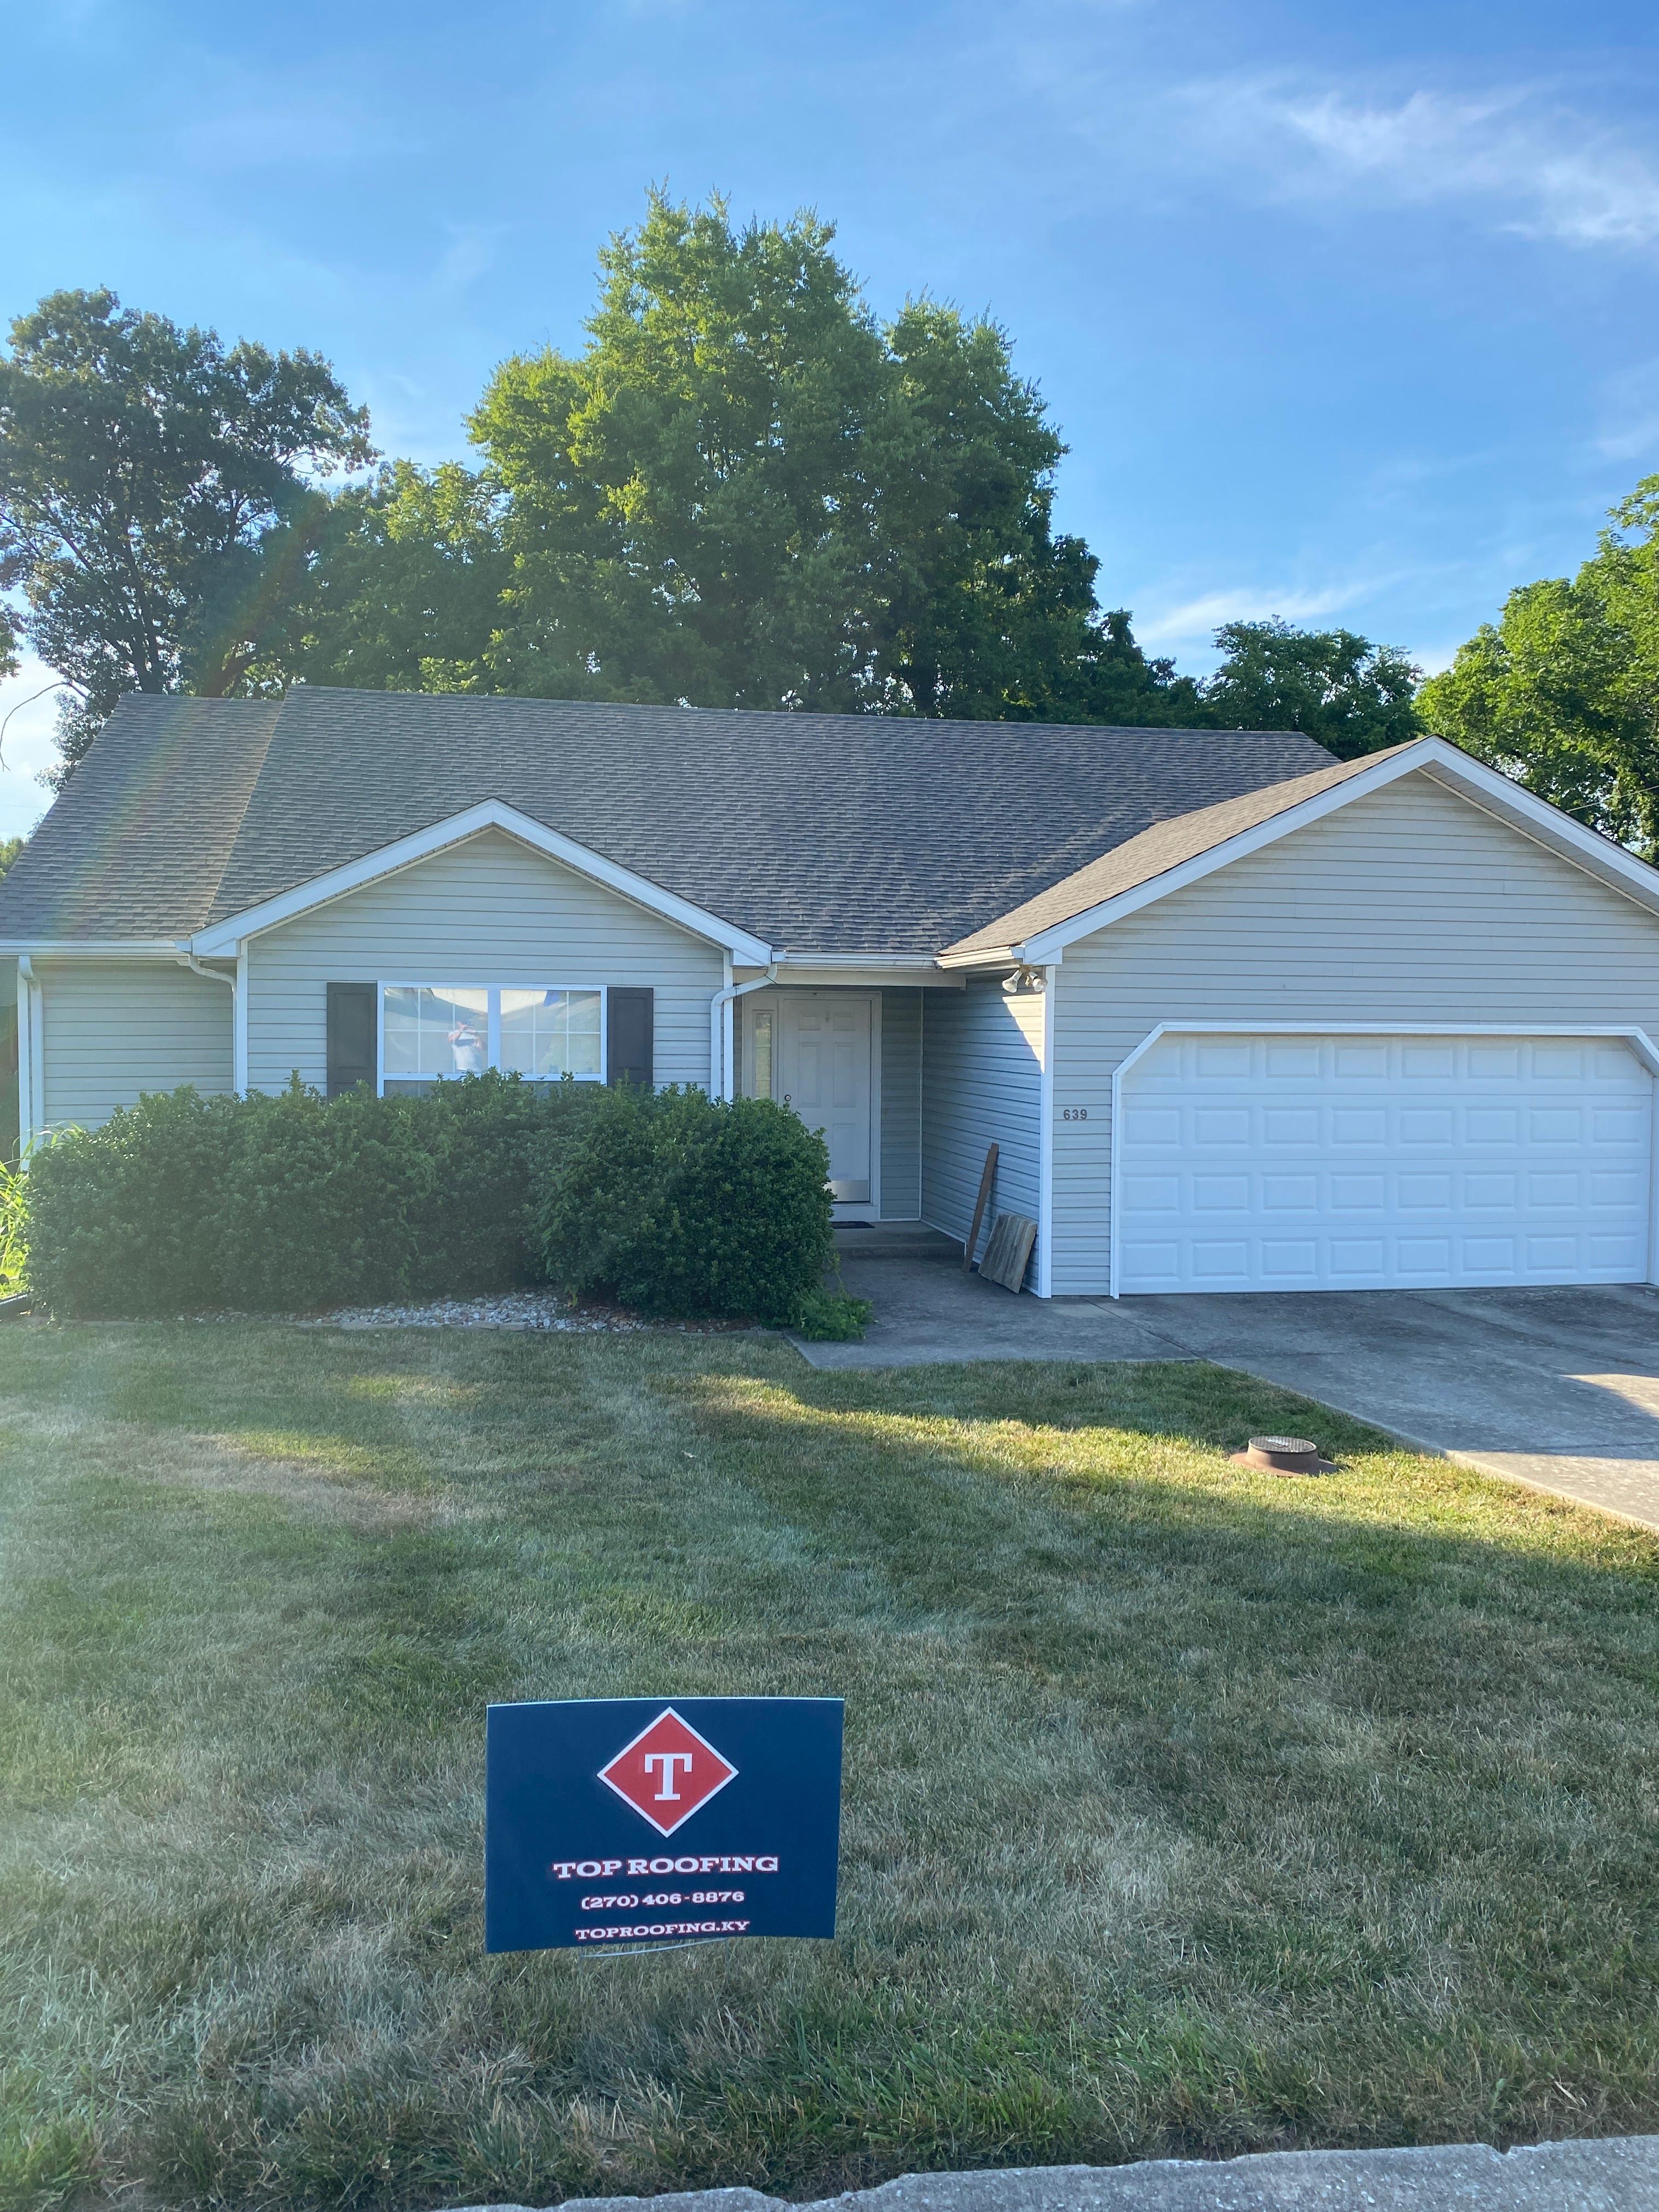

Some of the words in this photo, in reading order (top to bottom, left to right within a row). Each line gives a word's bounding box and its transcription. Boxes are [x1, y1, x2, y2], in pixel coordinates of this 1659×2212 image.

[1063, 1109, 1087, 1120] 639
[644, 1753, 692, 1801] T
[553, 1860, 622, 1878] TOP
[627, 1857, 779, 1875] ROOFING
[582, 1895, 639, 1910] (270)
[642, 1891, 745, 1905] 406-8876
[575, 1920, 750, 1940] TOPROOFING.KY
